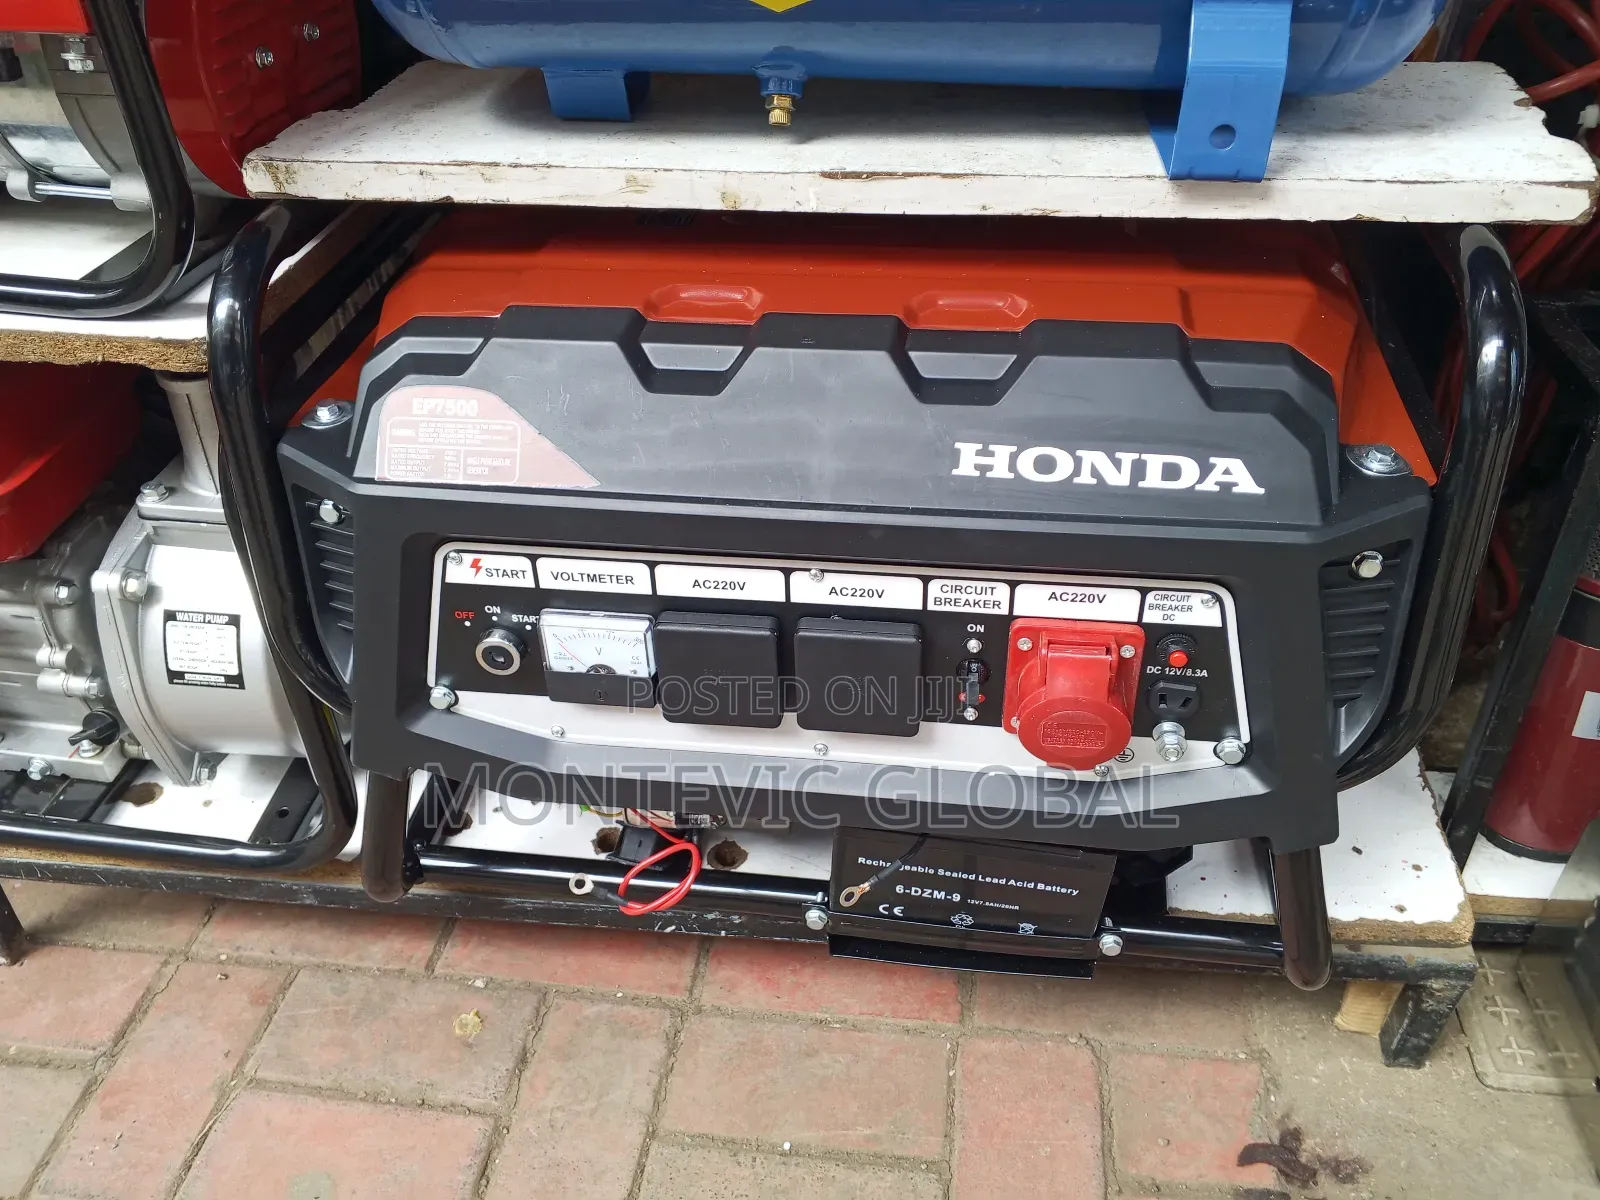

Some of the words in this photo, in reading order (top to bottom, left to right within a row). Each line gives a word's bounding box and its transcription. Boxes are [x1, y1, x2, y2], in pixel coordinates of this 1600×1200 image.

[952, 442, 1265, 495] HONDA
[486, 568, 527, 580] START
[551, 571, 634, 585] VOLTMETER
[692, 579, 746, 591] AC220V
[940, 584, 997, 596] CIRCUIT
[829, 585, 885, 599] AC220V
[1048, 591, 1107, 604] AC220V
[1154, 592, 1191, 603] CIRCUIT
[933, 596, 1002, 610] BREAKER
[1148, 603, 1193, 613] BREAKER
[455, 611, 474, 620] OFF
[485, 605, 500, 614] ON
[176, 612, 204, 623] WATER
[205, 614, 228, 625] PUMP
[1162, 613, 1175, 622] DC
[967, 623, 984, 633] ON
[595, 647, 602, 656] V
[1146, 666, 1162, 675] DC
[1164, 666, 1208, 678] 12V/8.3A
[937, 868, 976, 881] Sealed
[979, 874, 1006, 886] Lead
[1008, 878, 1034, 890] Acid
[1038, 882, 1080, 896] Battery
[896, 884, 961, 902] 6-DZM-9
[879, 904, 904, 917] CE
